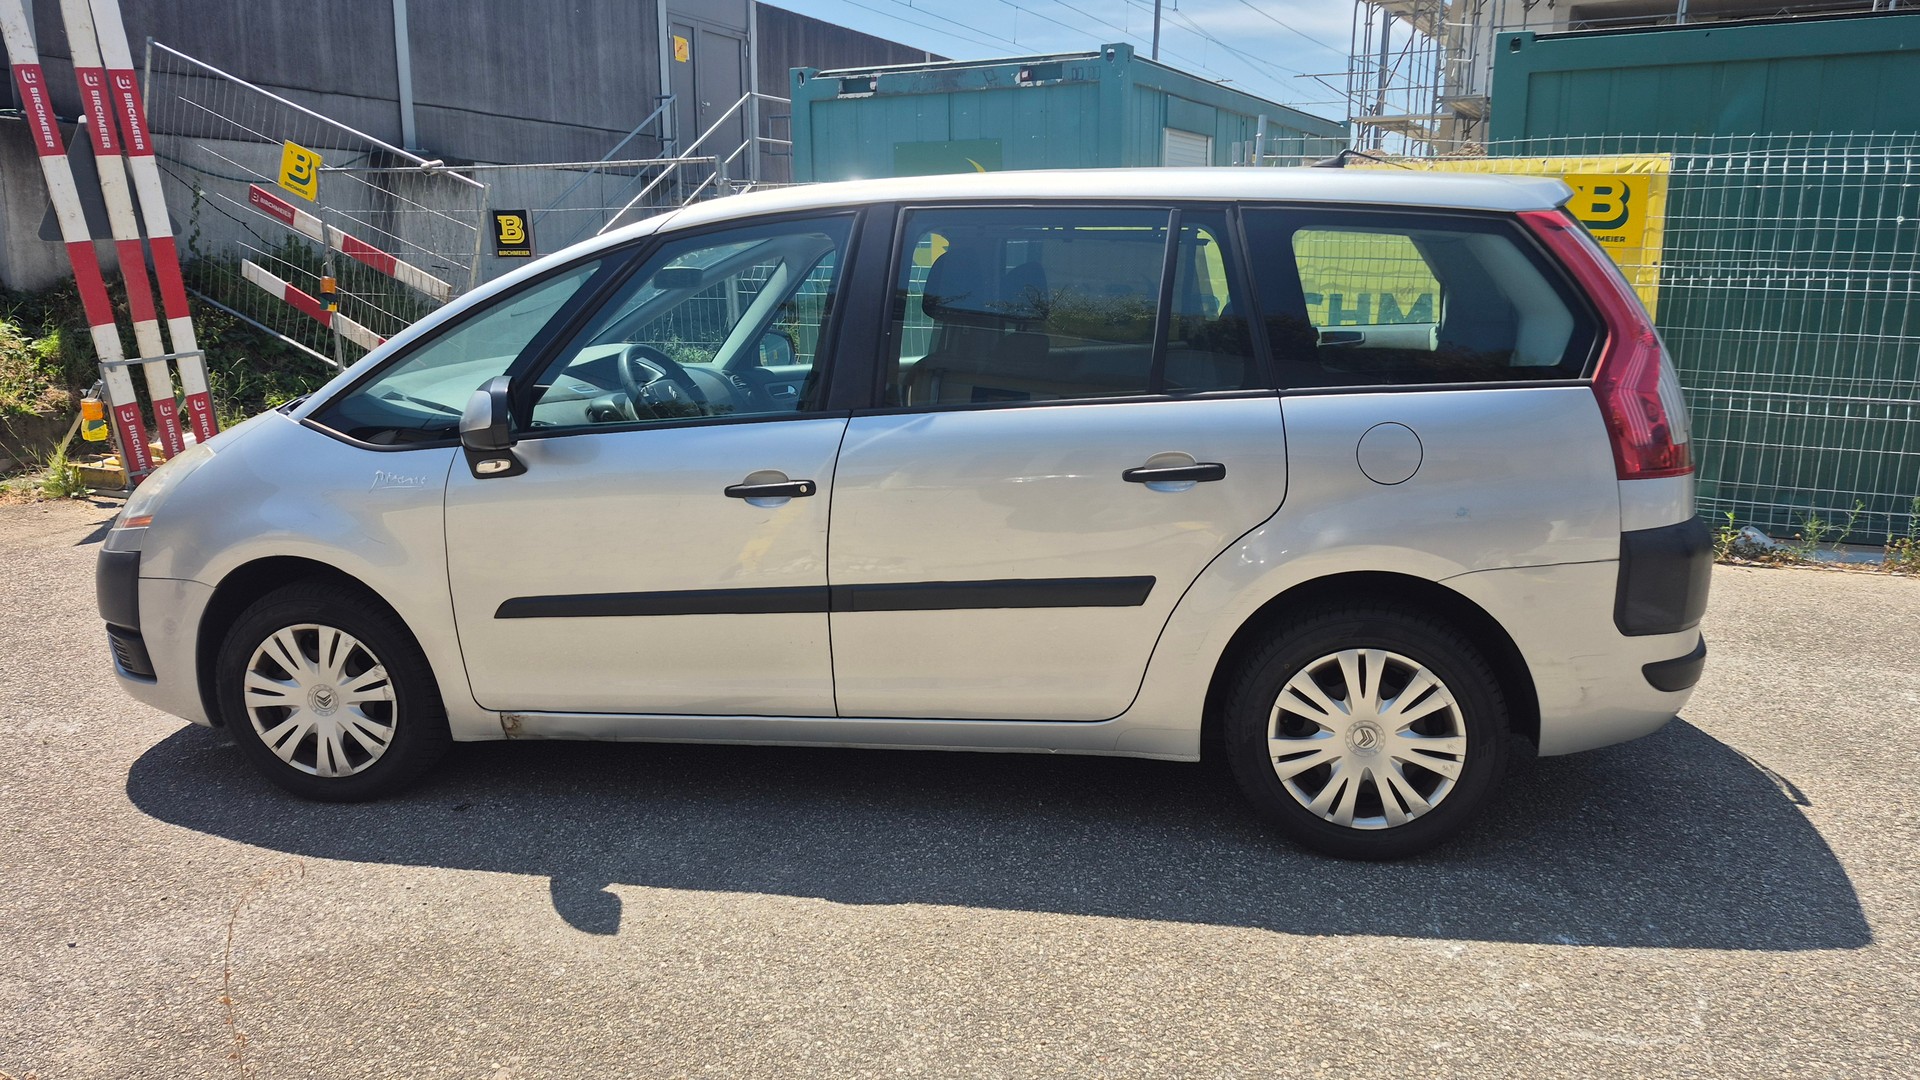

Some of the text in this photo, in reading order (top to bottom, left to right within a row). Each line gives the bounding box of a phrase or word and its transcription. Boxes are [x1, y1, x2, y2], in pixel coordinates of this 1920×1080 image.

[29, 87, 55, 148] BIRCHMEIER
[90, 90, 111, 149] BIRCHMEIER
[123, 92, 144, 150] BIRCHMEIER
[286, 150, 313, 186] B
[259, 197, 292, 219] BIRCHMEIER
[496, 214, 526, 245] B
[1574, 178, 1631, 231] B
